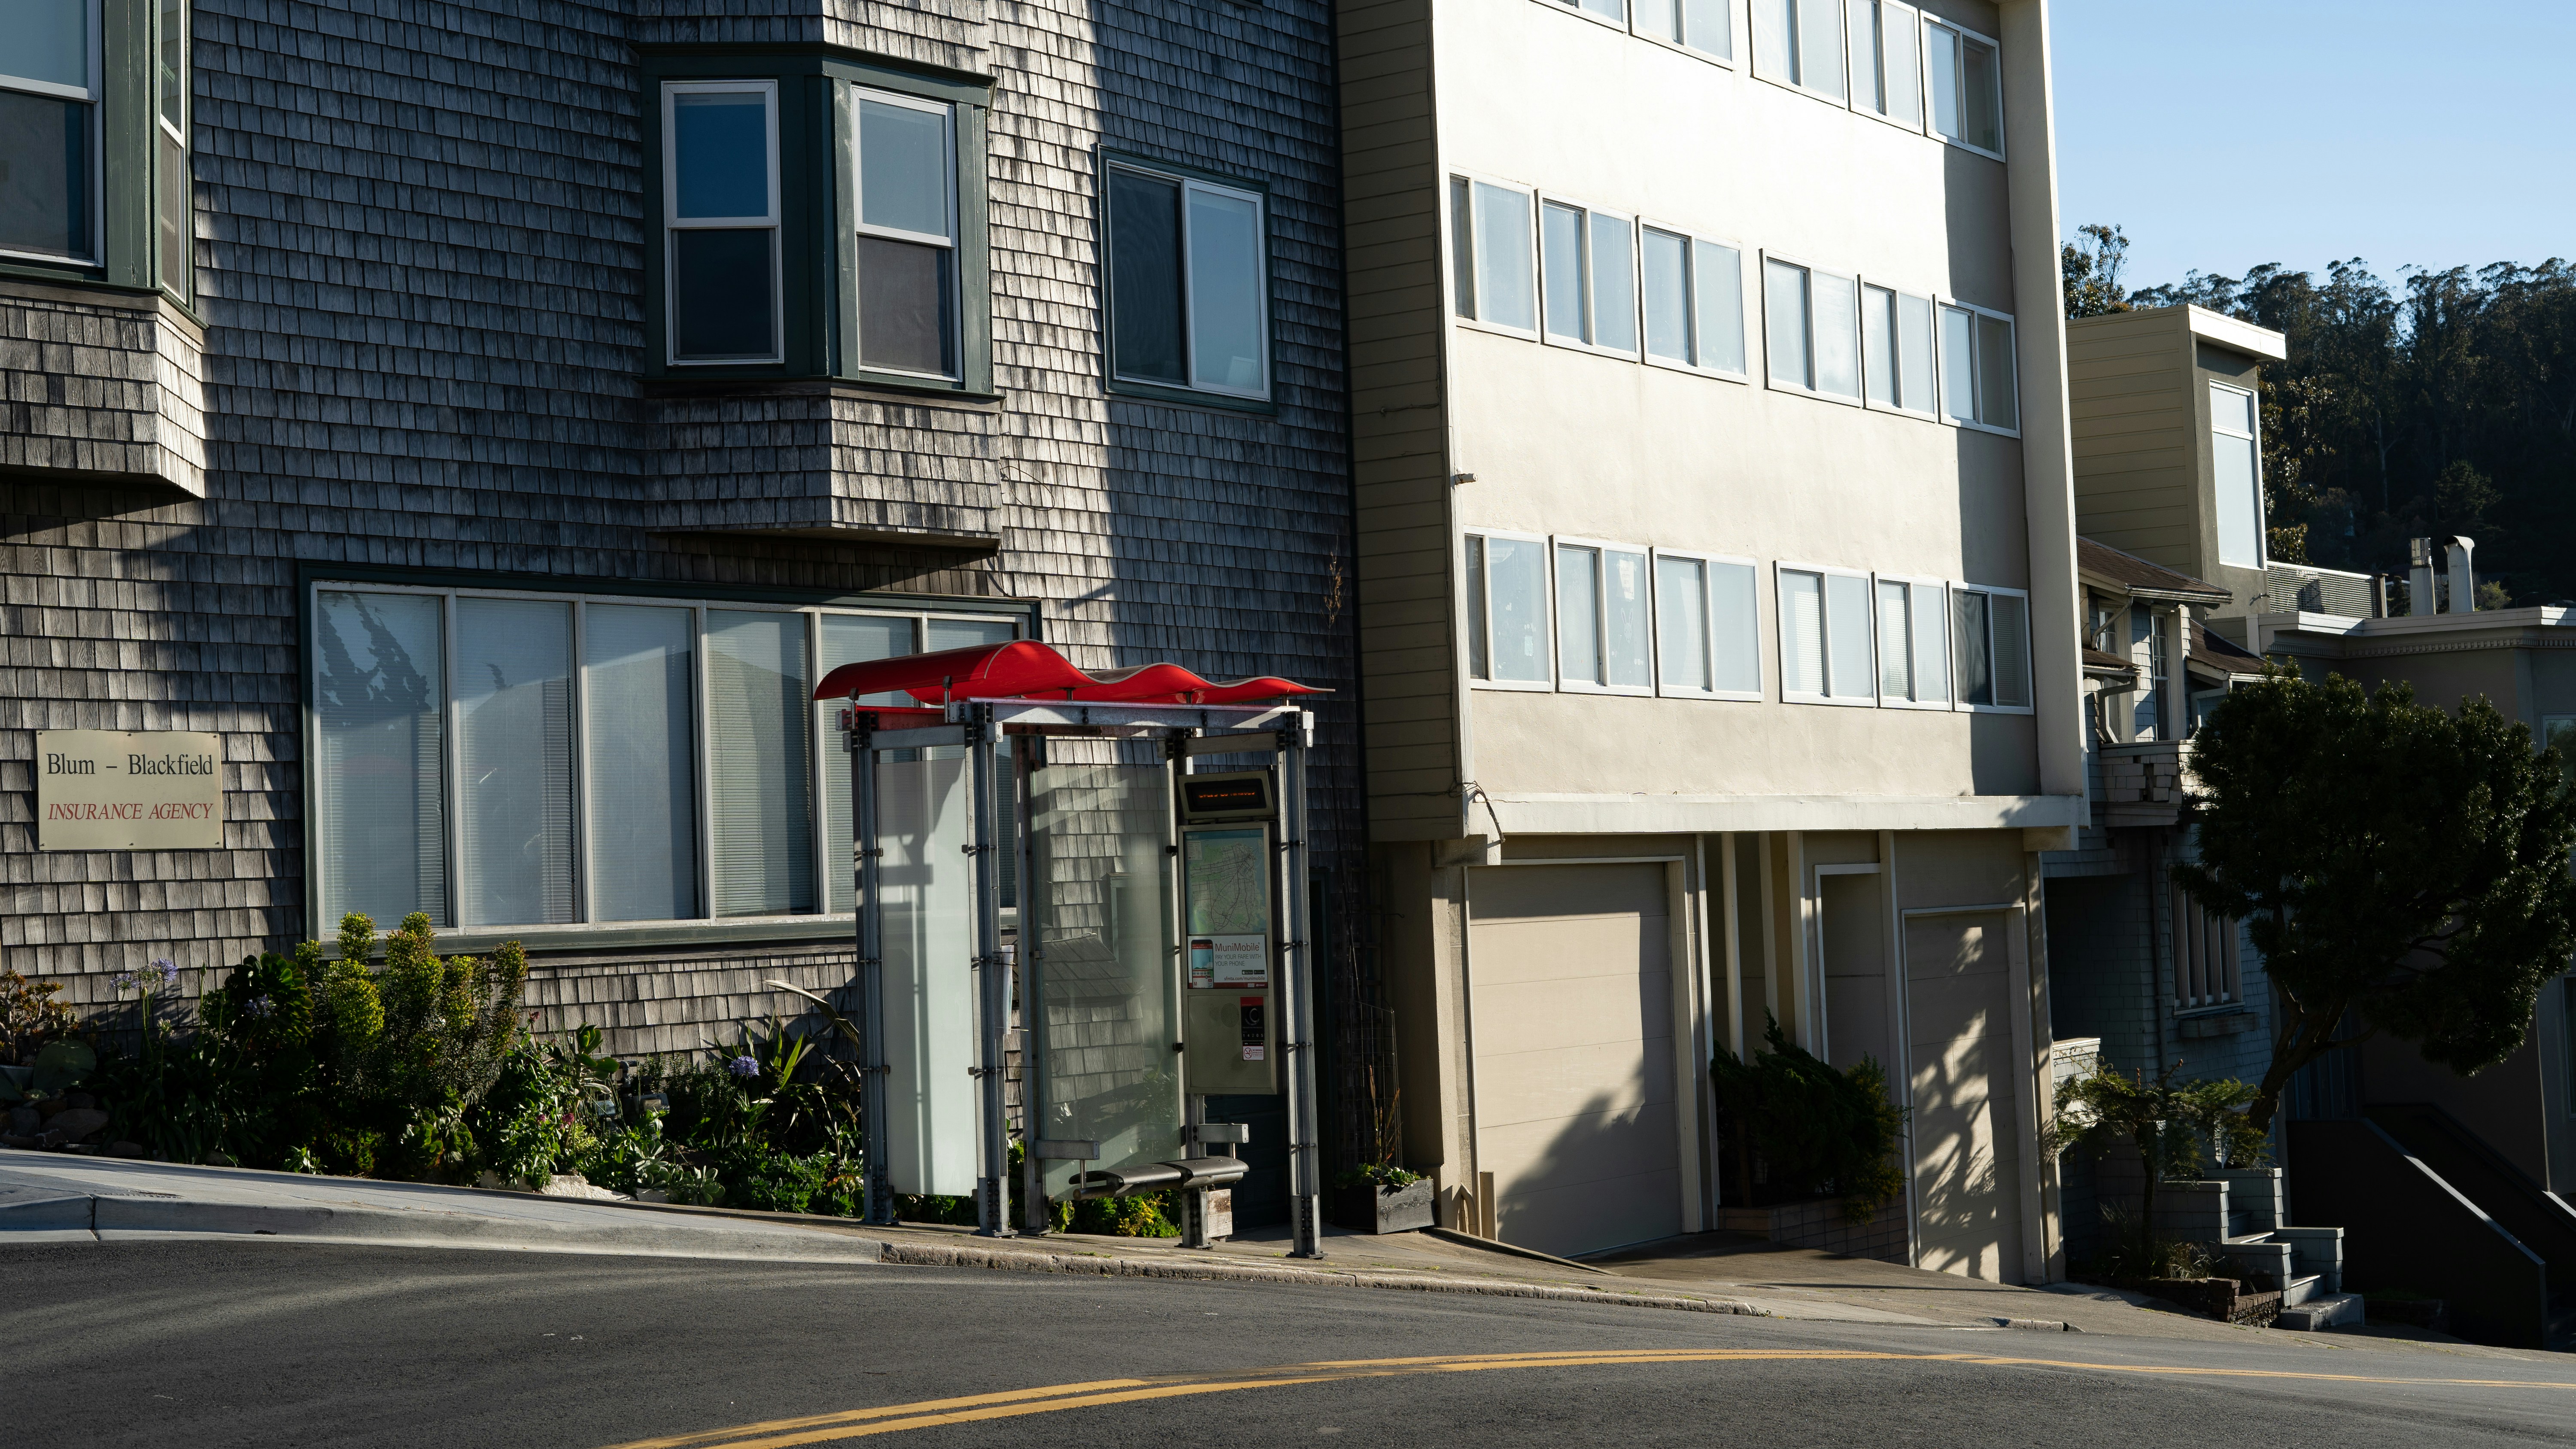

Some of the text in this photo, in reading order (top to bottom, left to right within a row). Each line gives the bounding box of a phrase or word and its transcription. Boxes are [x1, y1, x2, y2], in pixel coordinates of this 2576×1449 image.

[46, 753, 95, 775] Blum
[128, 753, 213, 775] Blackfield
[48, 803, 214, 820] INSURANCE AGENCY
